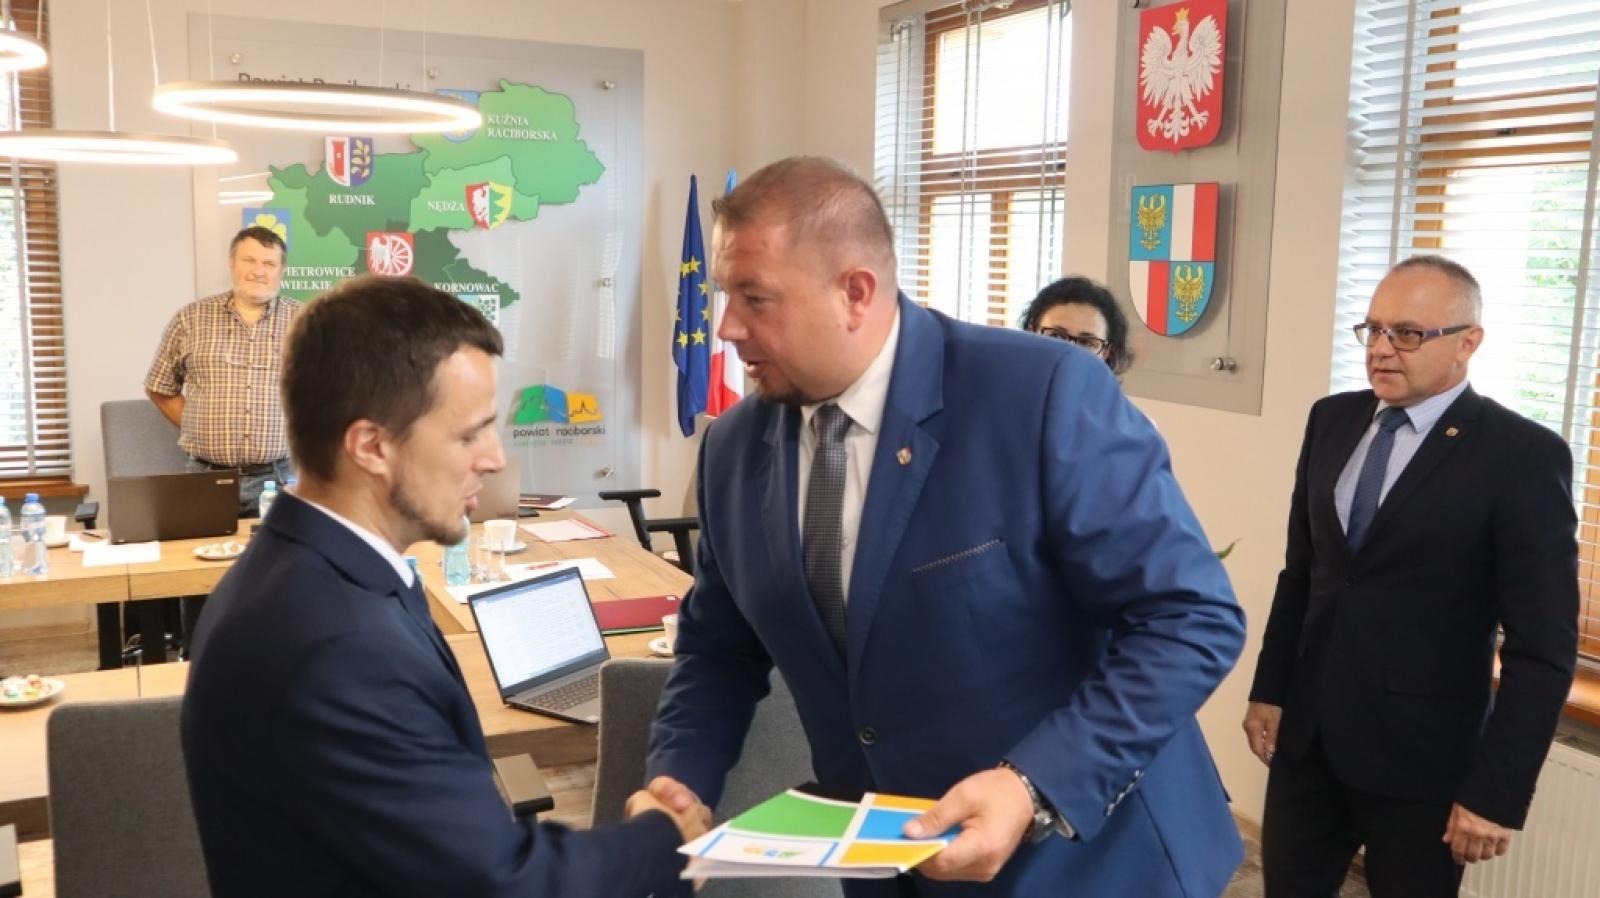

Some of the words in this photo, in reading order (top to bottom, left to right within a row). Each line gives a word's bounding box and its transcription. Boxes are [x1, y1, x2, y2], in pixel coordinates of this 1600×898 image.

[488, 127, 558, 140] RACIBORSKA
[329, 194, 375, 205] RUDNIK
[284, 266, 356, 277] IETROWICE
[433, 282, 499, 292] KORNOWAC
[513, 427, 549, 439] powiat
[556, 425, 606, 436] raciborski
